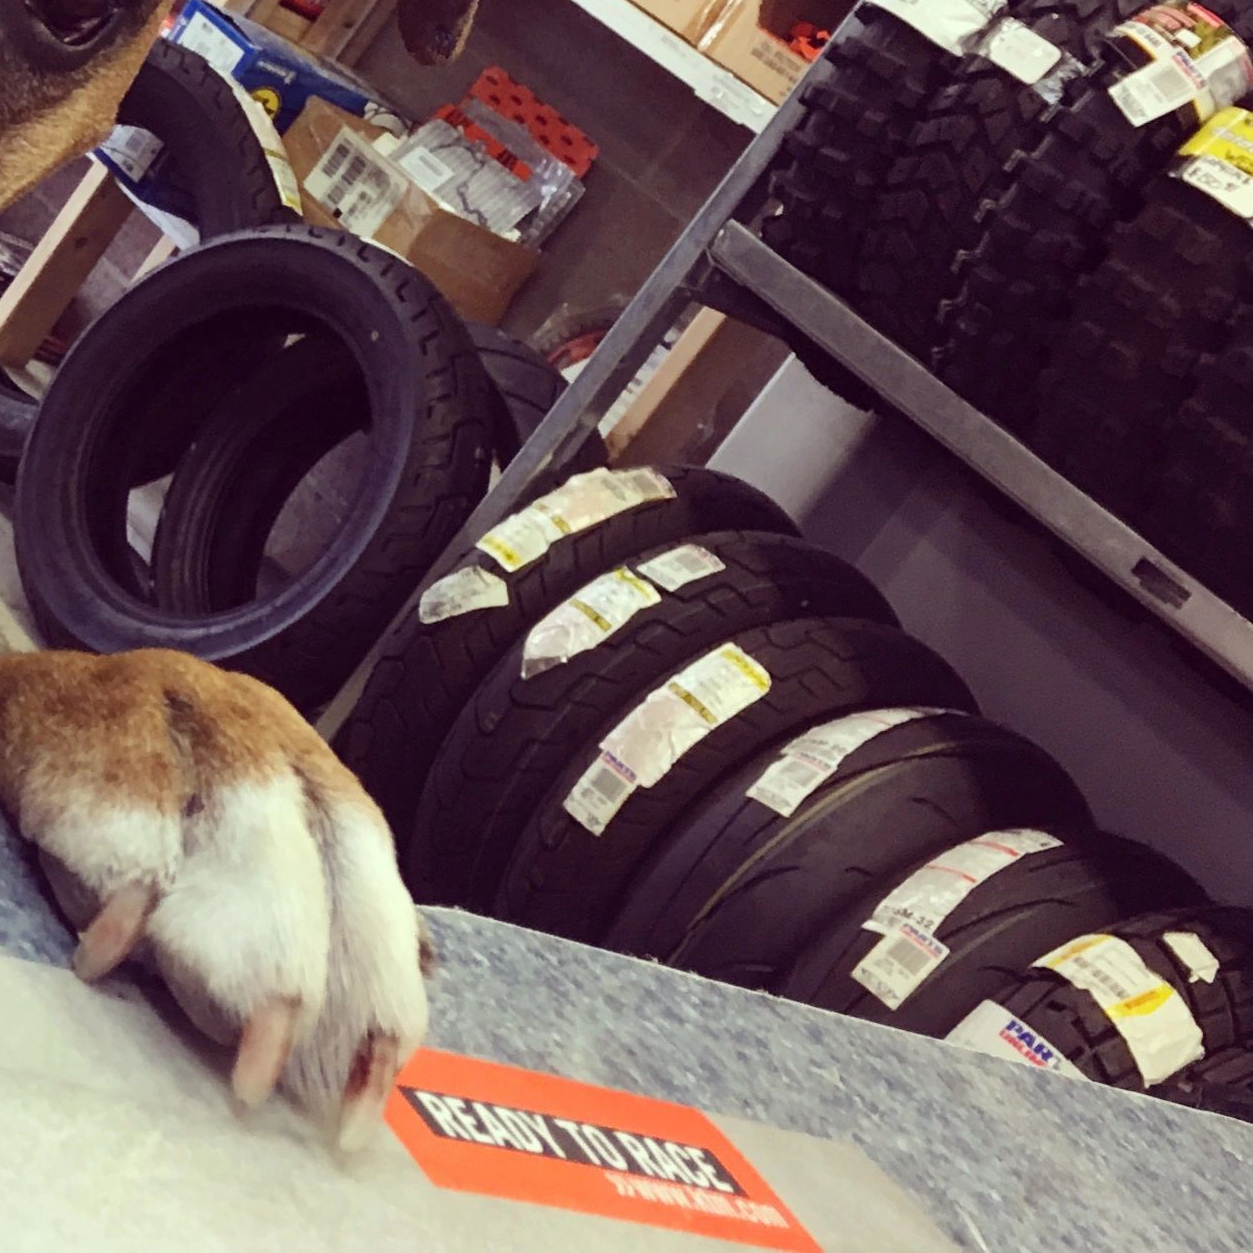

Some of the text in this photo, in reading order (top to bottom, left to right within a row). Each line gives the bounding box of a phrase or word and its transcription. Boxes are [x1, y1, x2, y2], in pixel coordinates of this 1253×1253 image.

[413, 1090, 735, 1194] READY TO RACE
